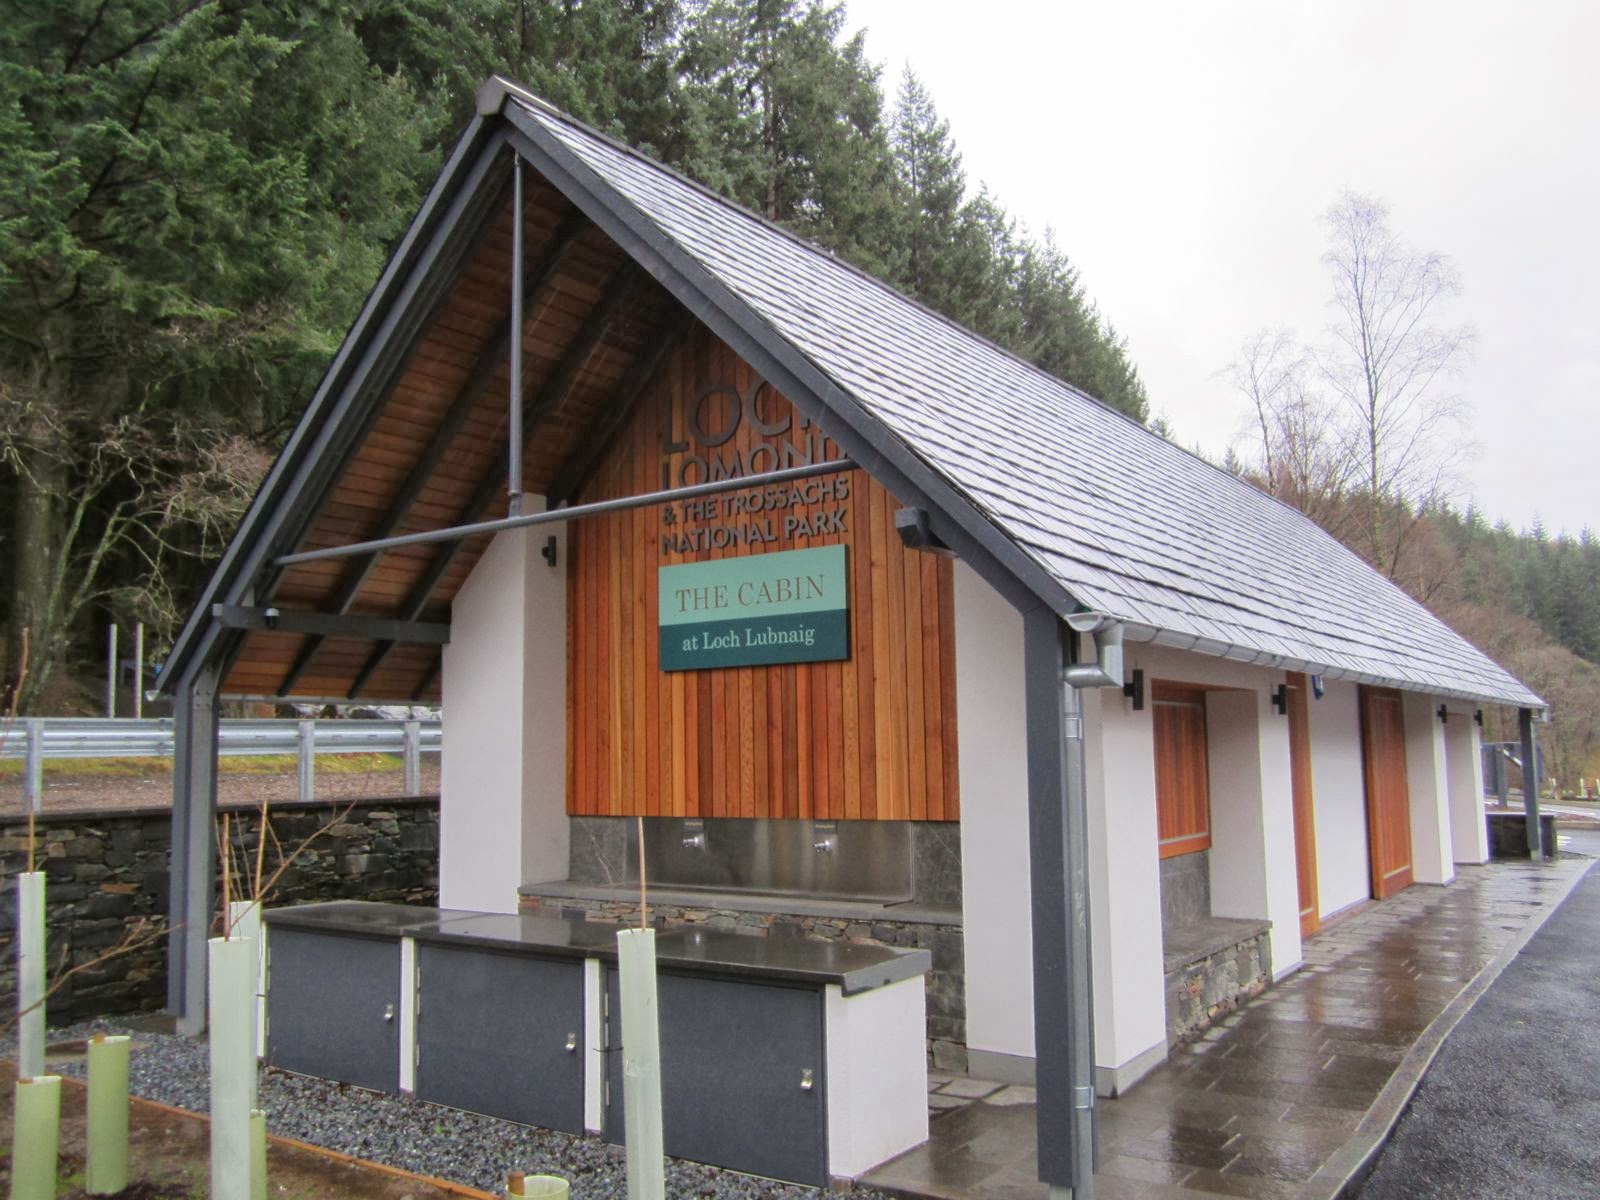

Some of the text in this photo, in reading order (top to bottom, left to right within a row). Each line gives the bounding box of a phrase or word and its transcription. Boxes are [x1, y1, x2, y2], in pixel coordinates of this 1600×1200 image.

[663, 377, 811, 452] LOC
[663, 479, 850, 526] & THE TROSSACHS
[661, 508, 849, 555] NATIONAL PARK
[675, 574, 825, 612] THE CABIN
[682, 624, 816, 652] at Loch Lubnaig
